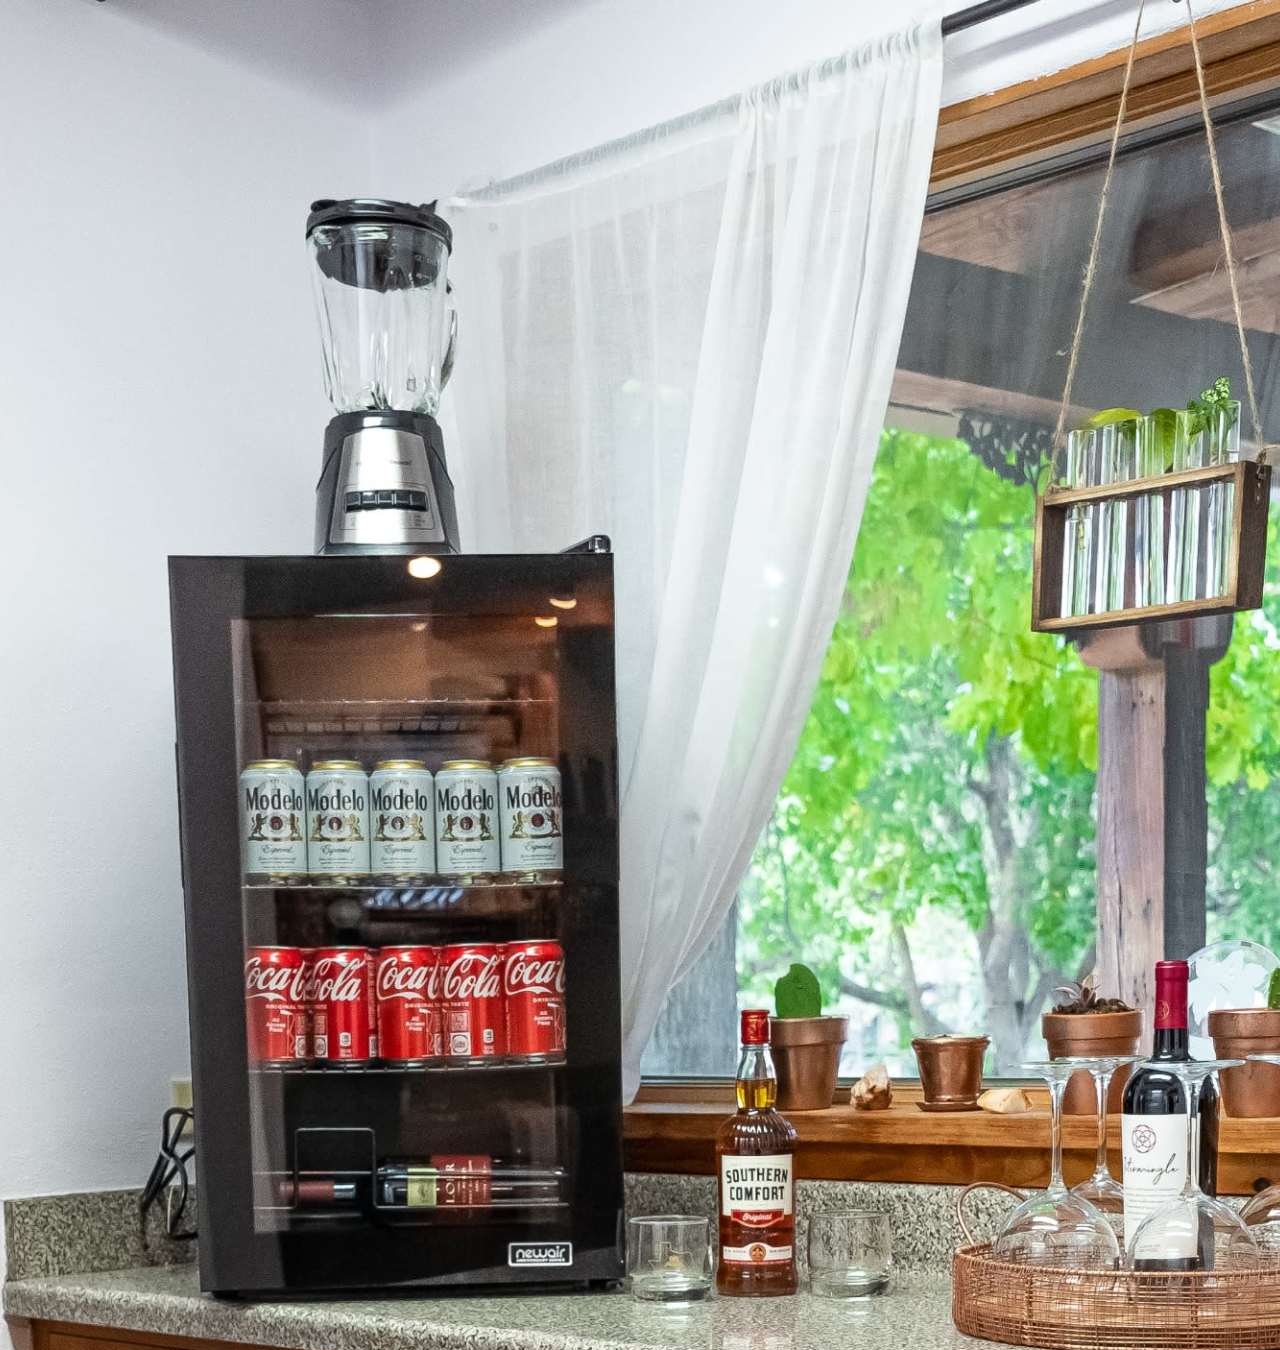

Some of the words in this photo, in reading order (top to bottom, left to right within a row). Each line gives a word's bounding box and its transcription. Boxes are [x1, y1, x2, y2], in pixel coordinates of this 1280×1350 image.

[246, 787, 303, 812] Modelo
[308, 788, 364, 812] Modelo
[372, 788, 428, 811] Modelo
[438, 788, 494, 812] Modelo
[725, 1167, 789, 1184] SOUTHERN
[729, 1186, 785, 1201] COMFORT
[742, 1212, 773, 1222] Original
[516, 1245, 566, 1258] newair
